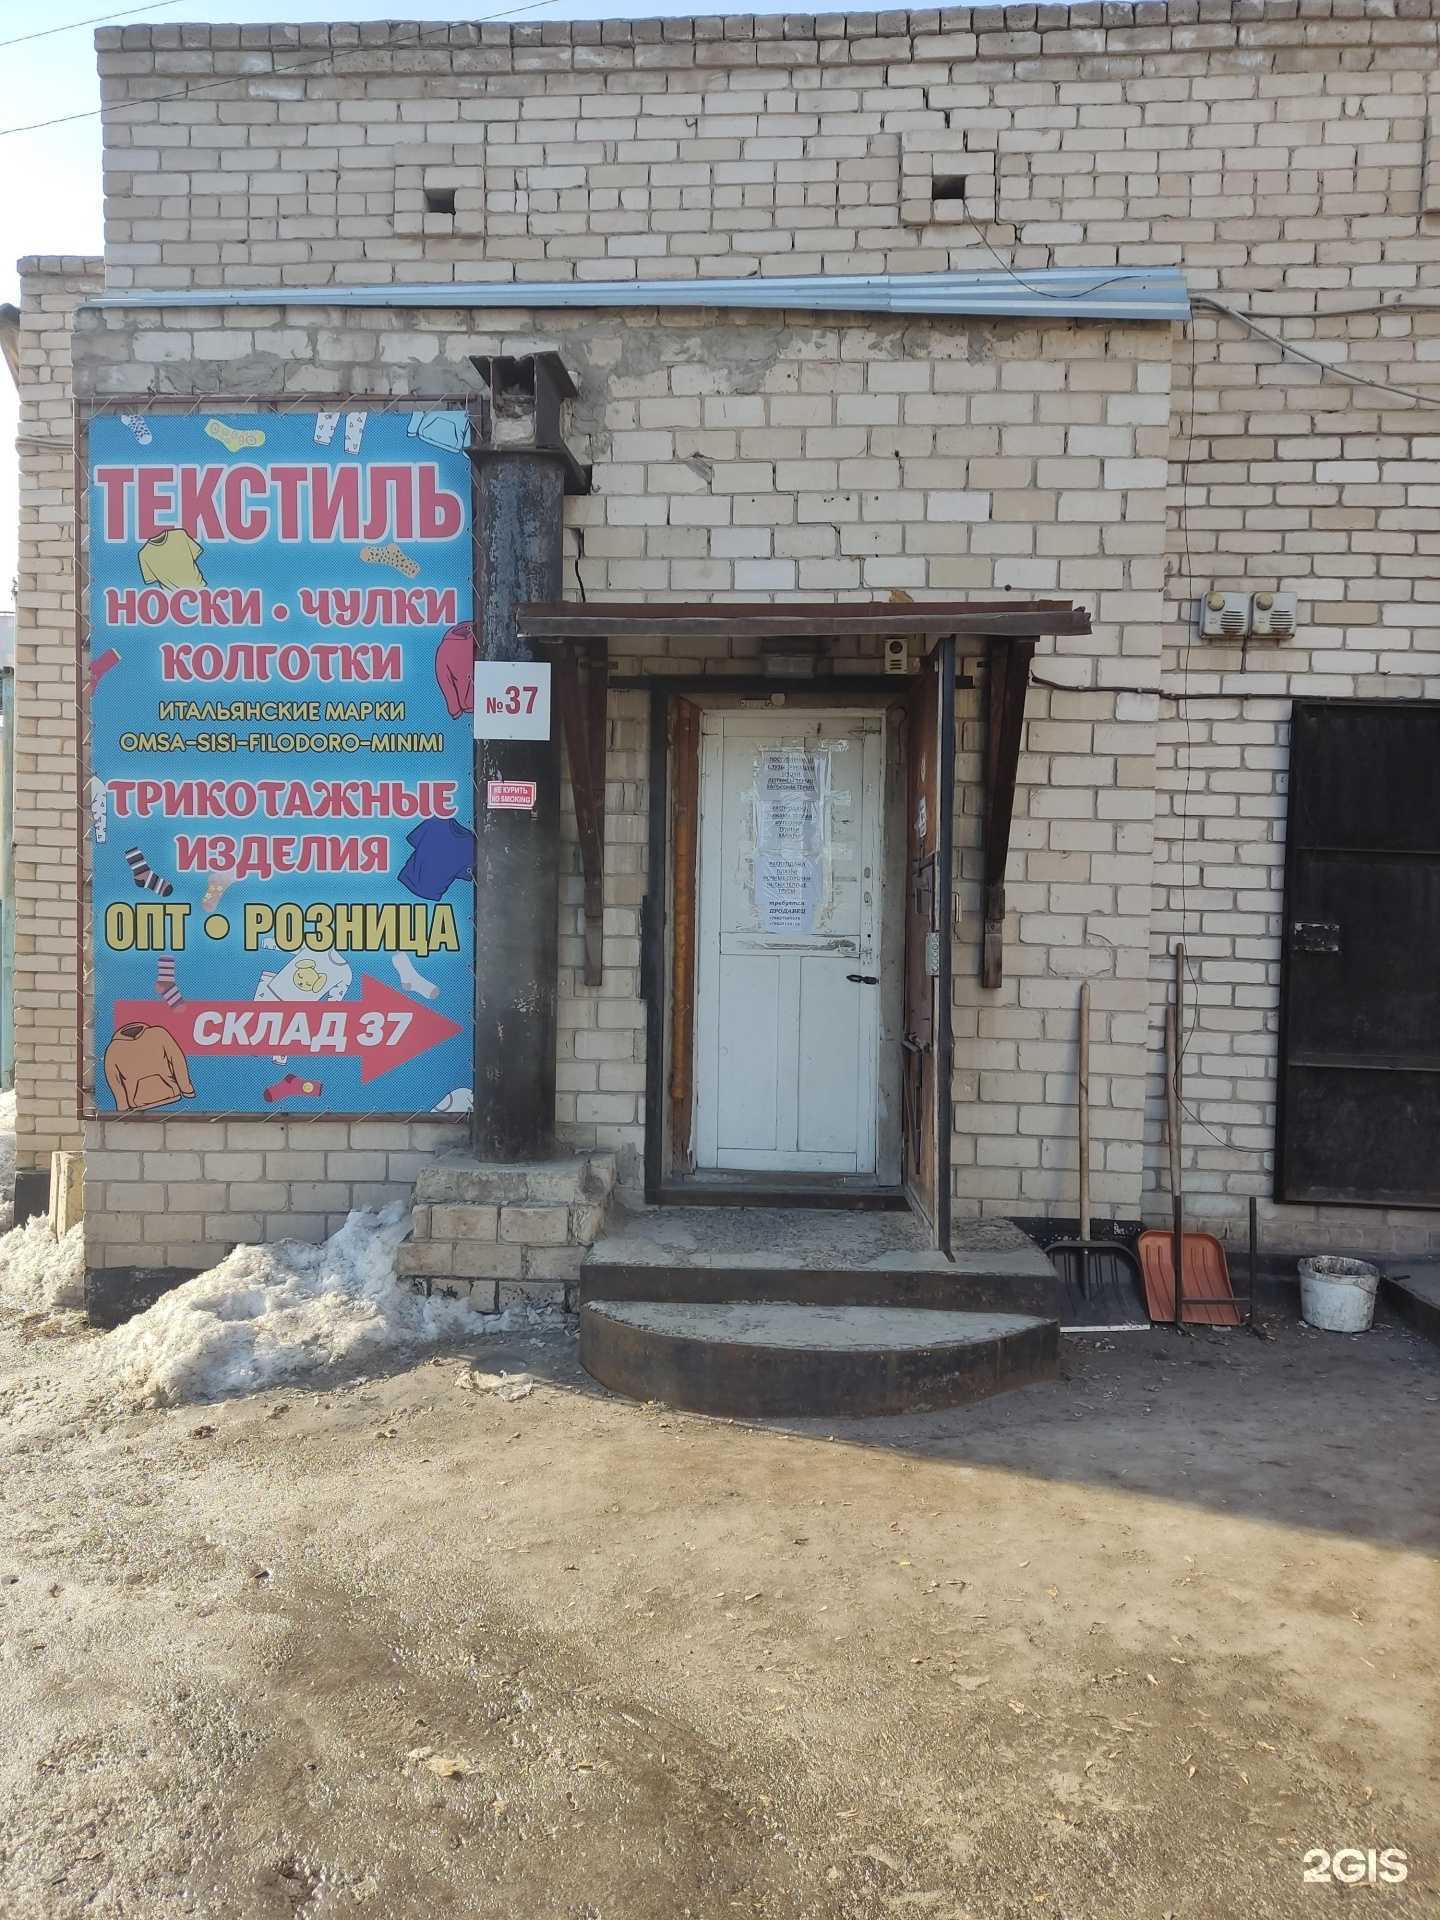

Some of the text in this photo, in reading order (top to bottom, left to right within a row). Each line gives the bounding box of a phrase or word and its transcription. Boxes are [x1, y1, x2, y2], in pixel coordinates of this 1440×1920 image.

[96, 464, 463, 542] ТЕКСТИЛЬ
[106, 588, 457, 626] НОСКИ ЧУЛКИ
[161, 644, 403, 682] КОЛГОТКИ
[158, 700, 405, 721] ИТАЛЬЯНСКИЕ МАРКИ
[106, 780, 458, 818] ТРИКОТАЖНЫЕ
[500, 795, 531, 804] SMOKING
[503, 786, 528, 795] КУРИТЬ
[176, 836, 389, 879] ИЗДЕЛИЯ
[105, 902, 460, 957] ОПТ РОЗНИЦА
[193, 1012, 414, 1052] СКЛАД 37
